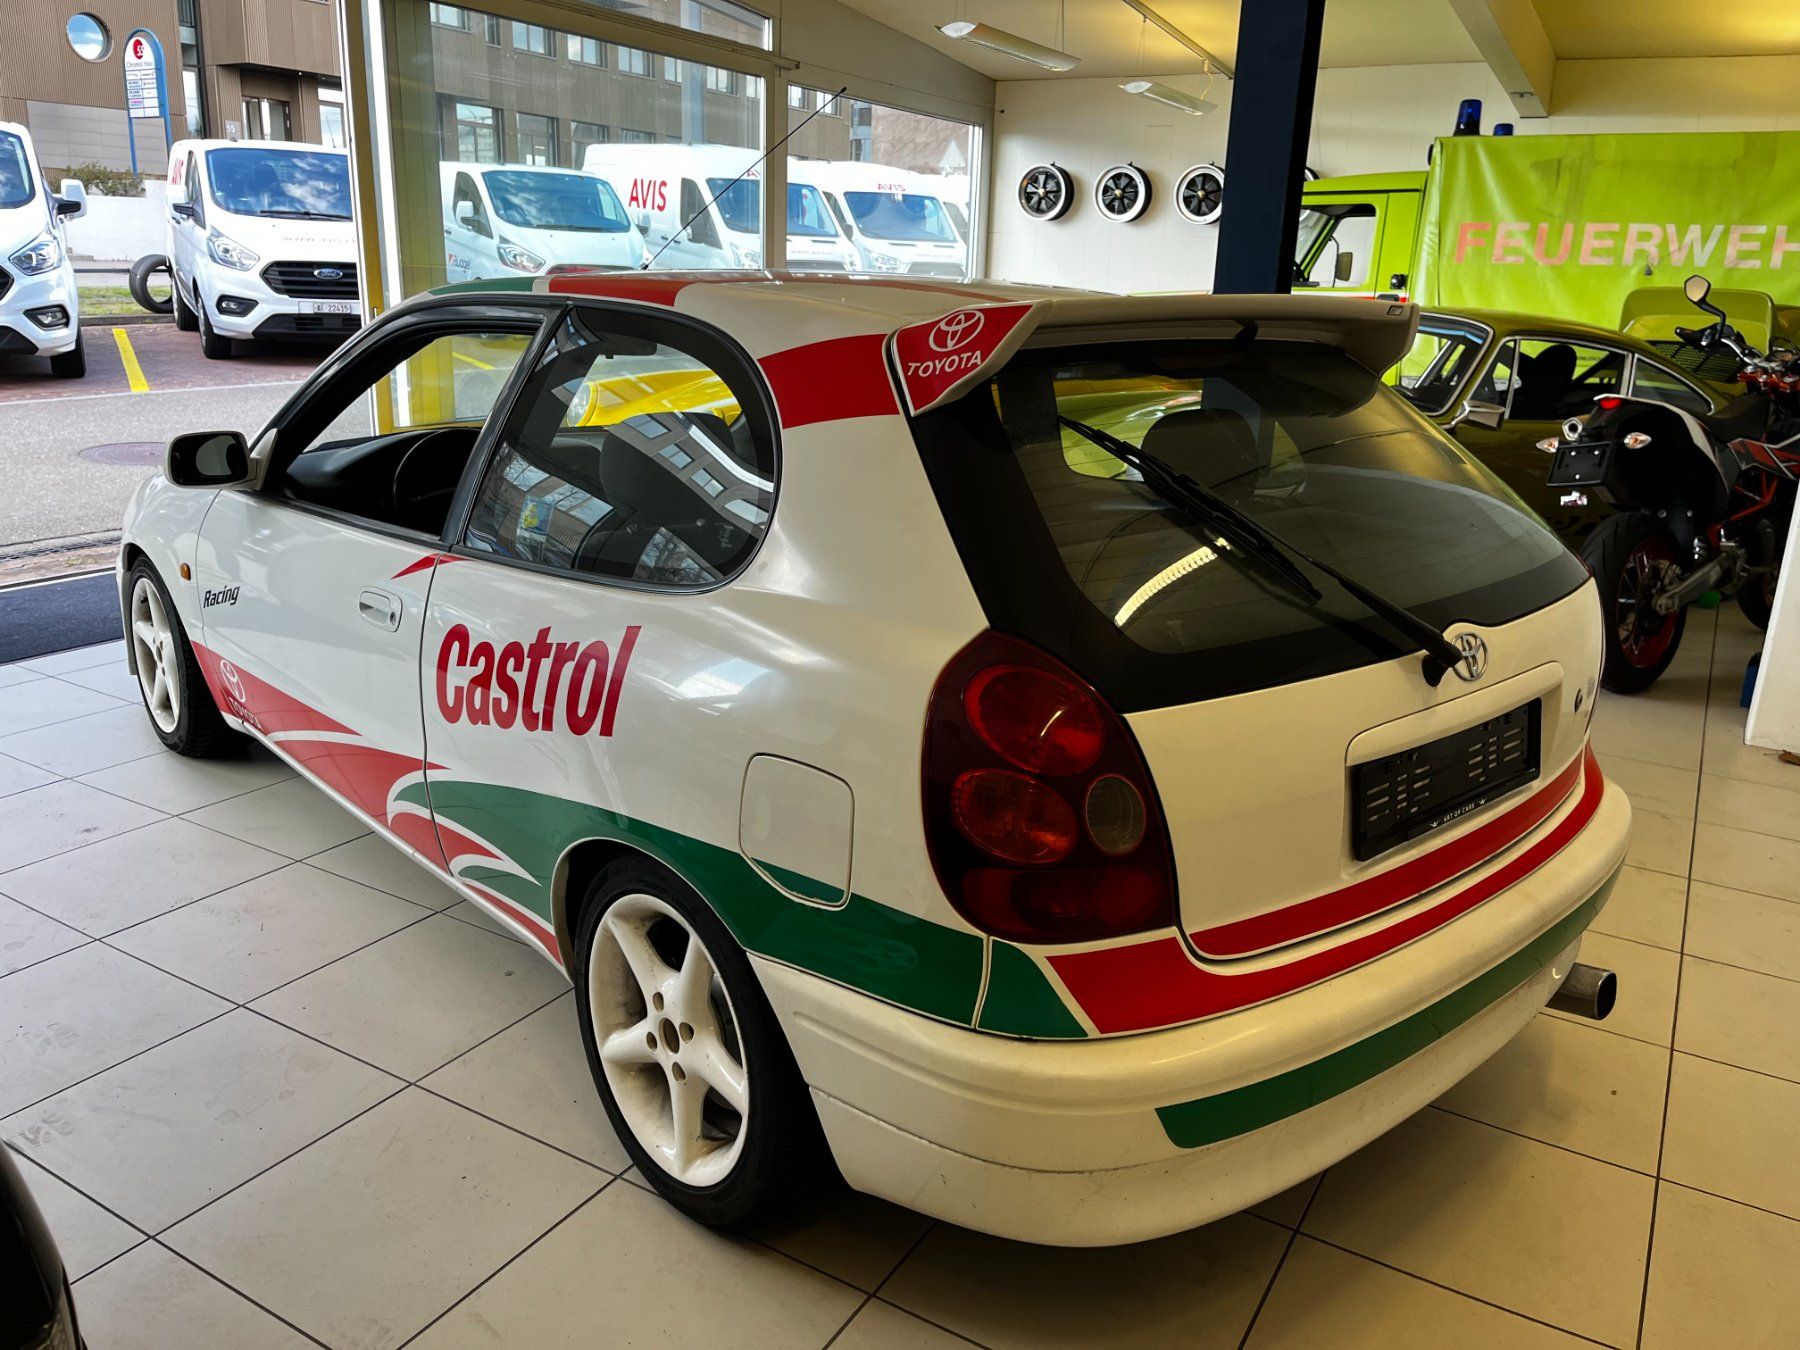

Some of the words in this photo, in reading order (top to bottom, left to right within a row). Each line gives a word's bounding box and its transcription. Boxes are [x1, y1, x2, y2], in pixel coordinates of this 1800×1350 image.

[628, 178, 668, 212] AVIS
[877, 183, 906, 192] AVIS
[907, 350, 982, 378] TOYOTA
[203, 585, 241, 609] Racing
[436, 623, 642, 737] Castrol
[1443, 813, 1453, 822] ART
[1462, 803, 1475, 814] CARS
